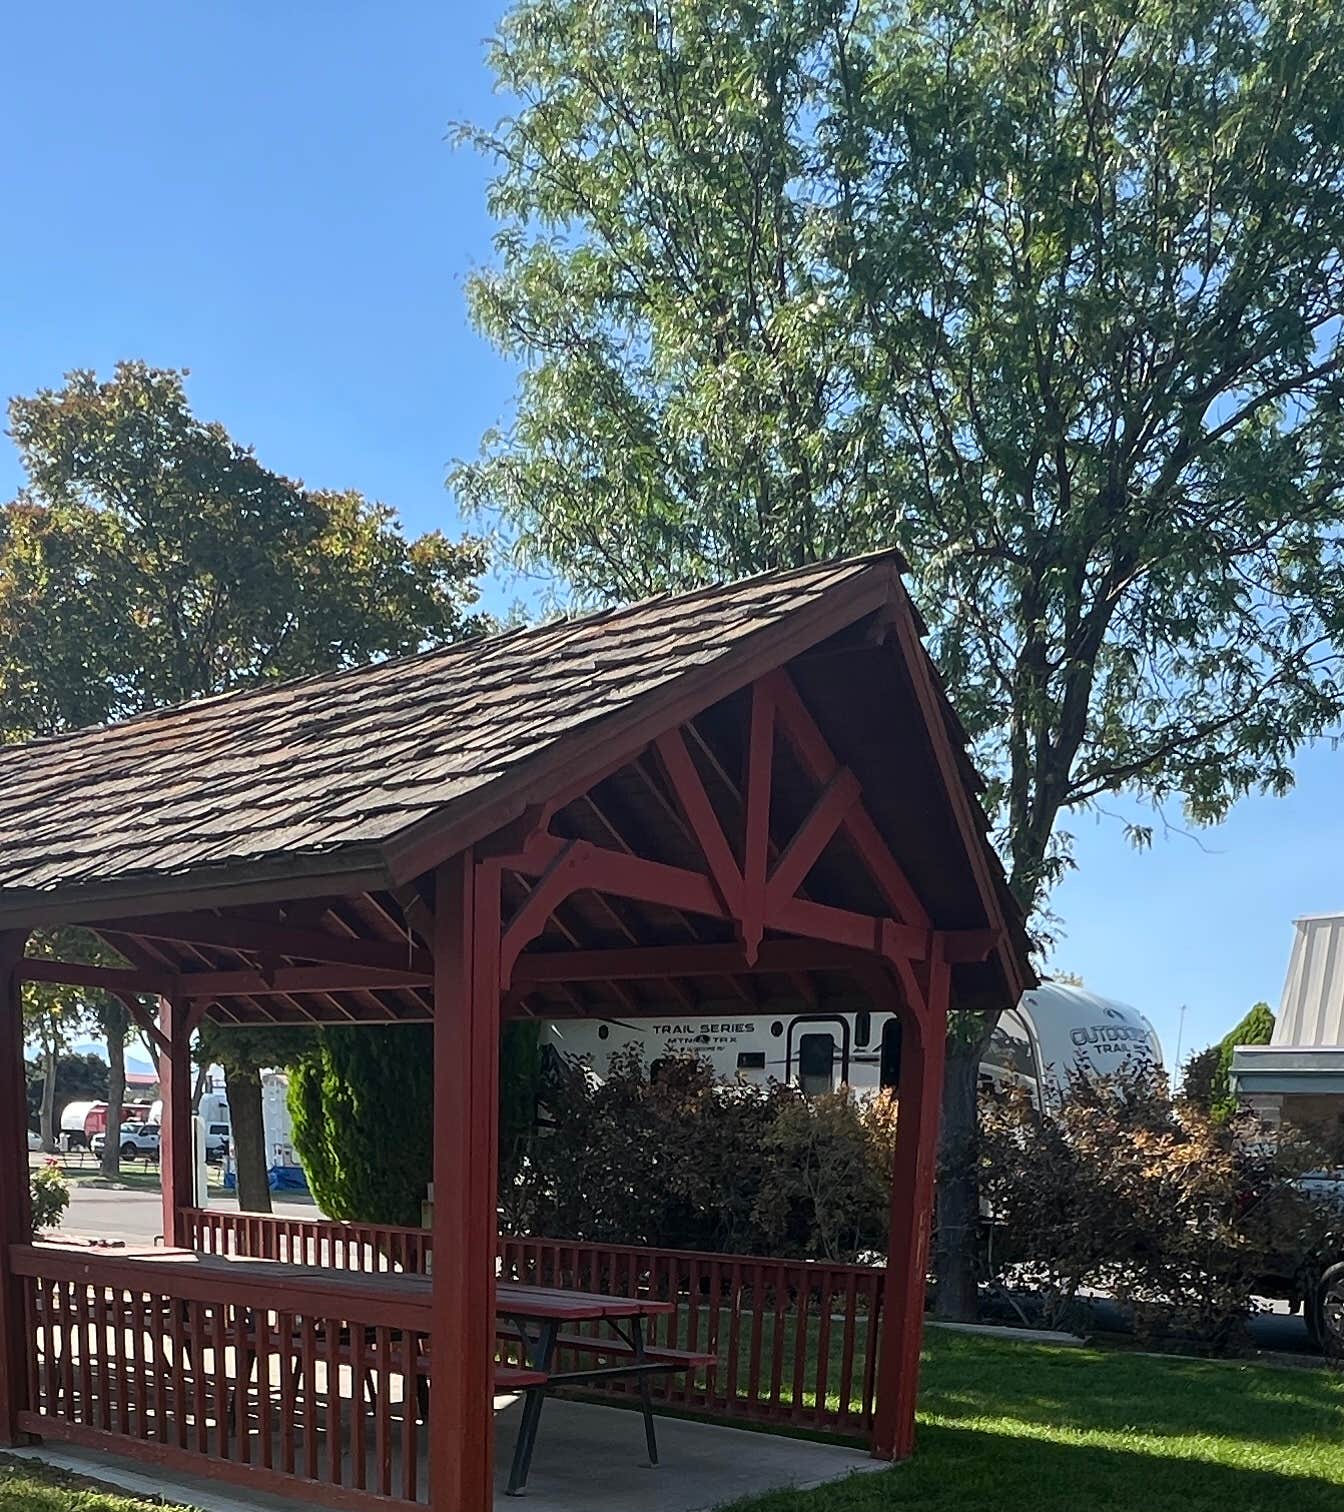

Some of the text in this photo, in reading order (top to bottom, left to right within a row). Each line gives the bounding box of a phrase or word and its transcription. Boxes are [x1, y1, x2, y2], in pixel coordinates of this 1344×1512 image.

[653, 1023, 755, 1034] TRAIL SERIES
[1070, 1025, 1146, 1046] OUTDOO
[1093, 1043, 1131, 1054] TRAIL
